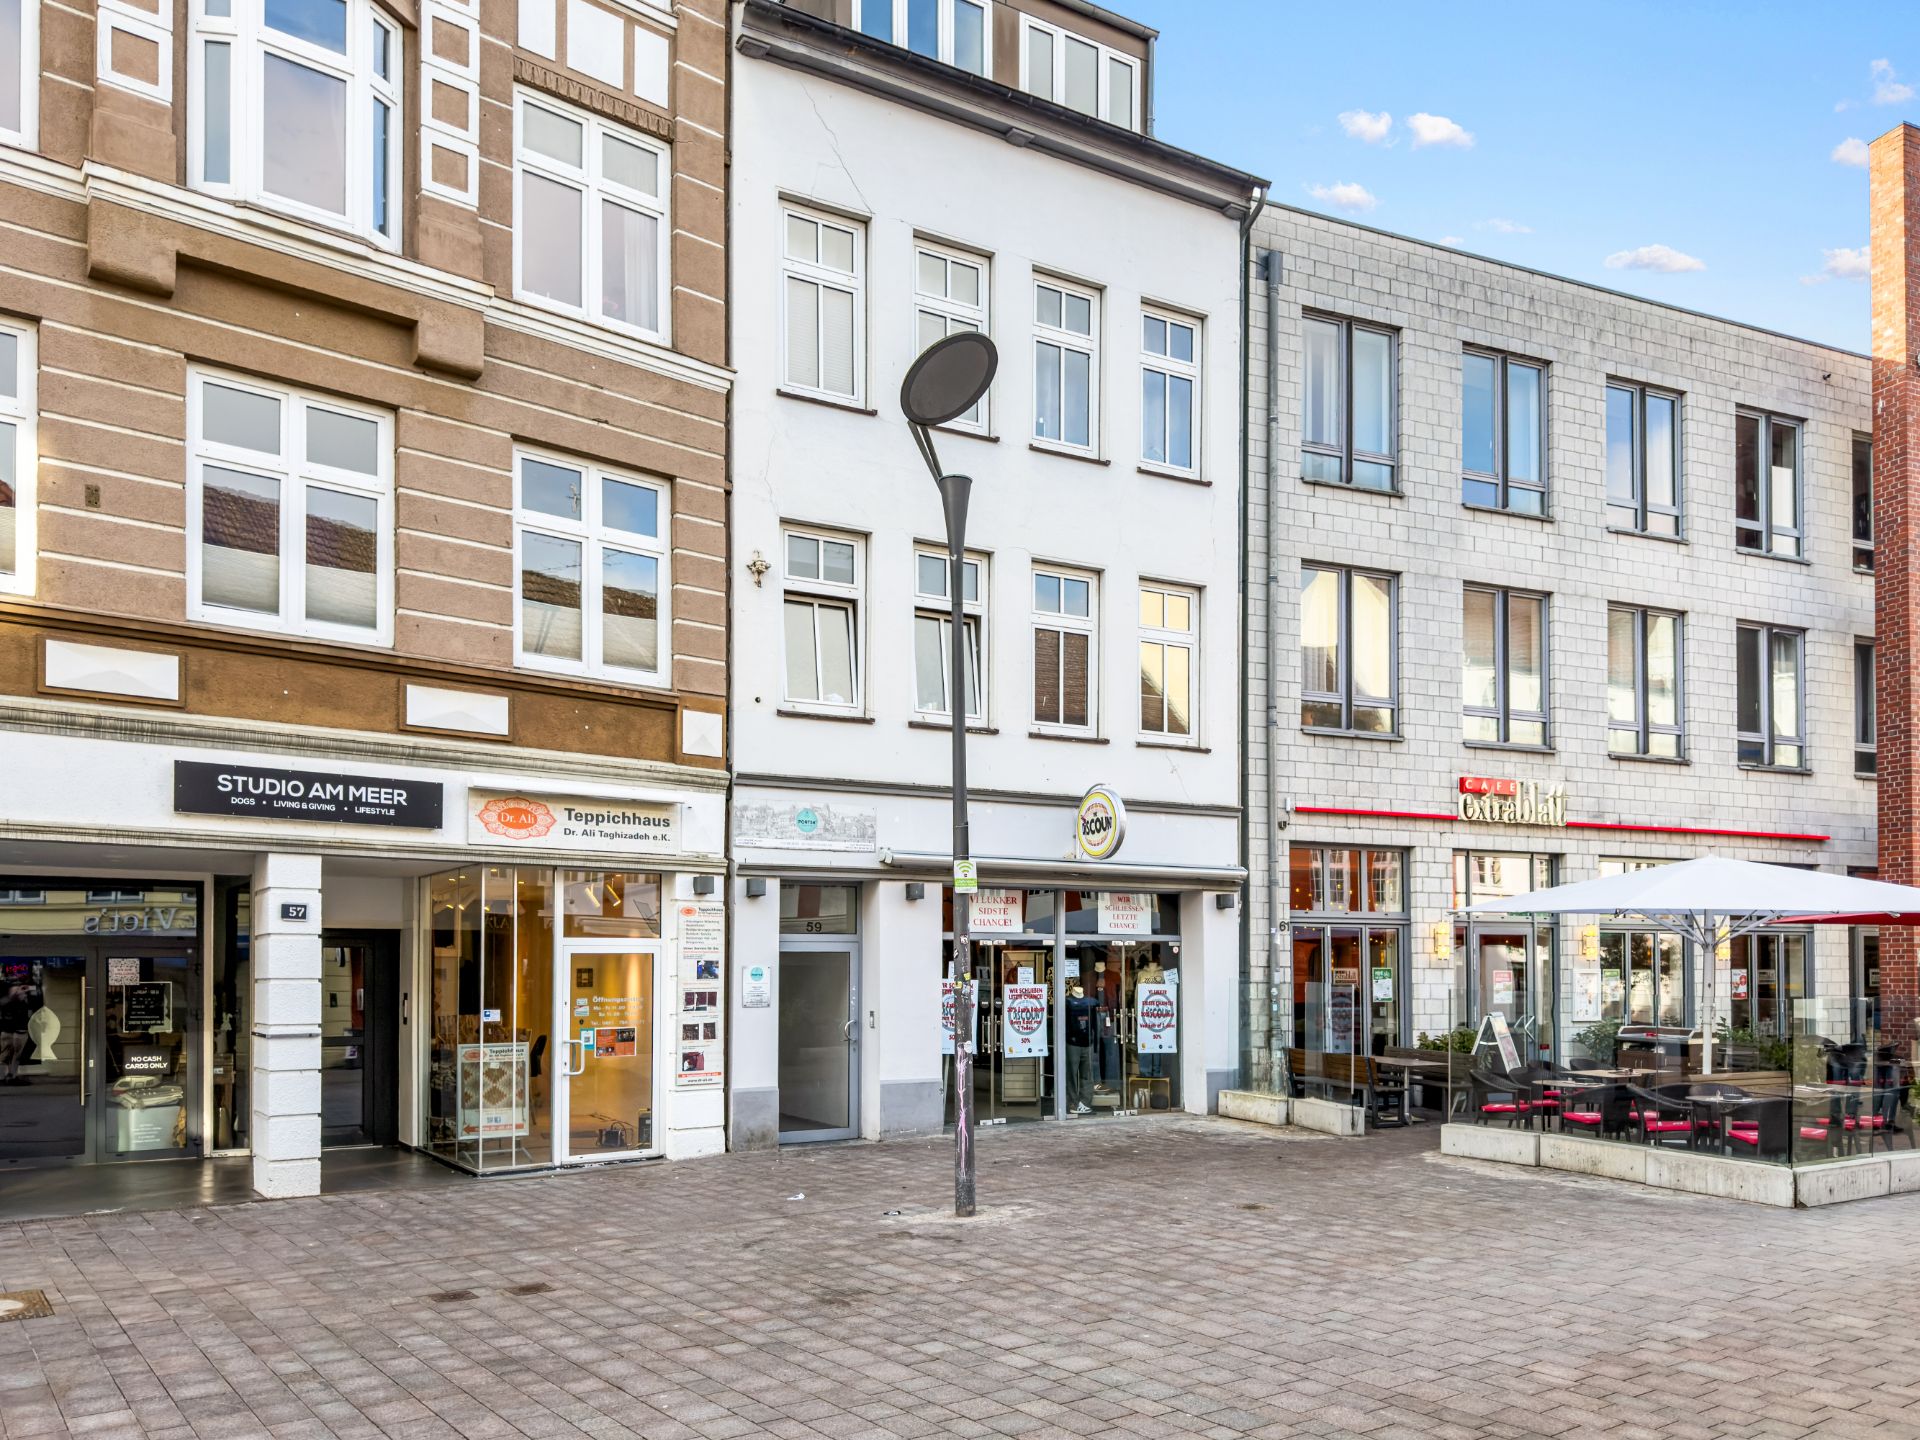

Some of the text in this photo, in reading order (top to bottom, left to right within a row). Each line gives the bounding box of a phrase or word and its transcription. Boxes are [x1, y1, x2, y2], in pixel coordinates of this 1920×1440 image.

[217, 774, 407, 806] STUDIO AM MEER
[1465, 779, 1516, 792] CAFE
[231, 796, 255, 806] DOGS
[273, 800, 300, 809] LIVING
[308, 803, 336, 812] GIVING
[355, 806, 396, 816] LIFESTYLE
[1459, 780, 1569, 826] extrablatt
[501, 812, 536, 825] Dr. Ali
[563, 807, 671, 828] Teppichhaus
[563, 827, 671, 842] Dr. Ali Taghizadeh e.K.
[981, 896, 1018, 905] LUKKER
[288, 906, 305, 917] 57
[978, 907, 1009, 915] SIDSTE
[1104, 904, 1144, 912] SCHLIESSEN
[806, 921, 822, 932] 59
[973, 918, 1012, 927] CHANCE!
[1279, 920, 1290, 932] 61
